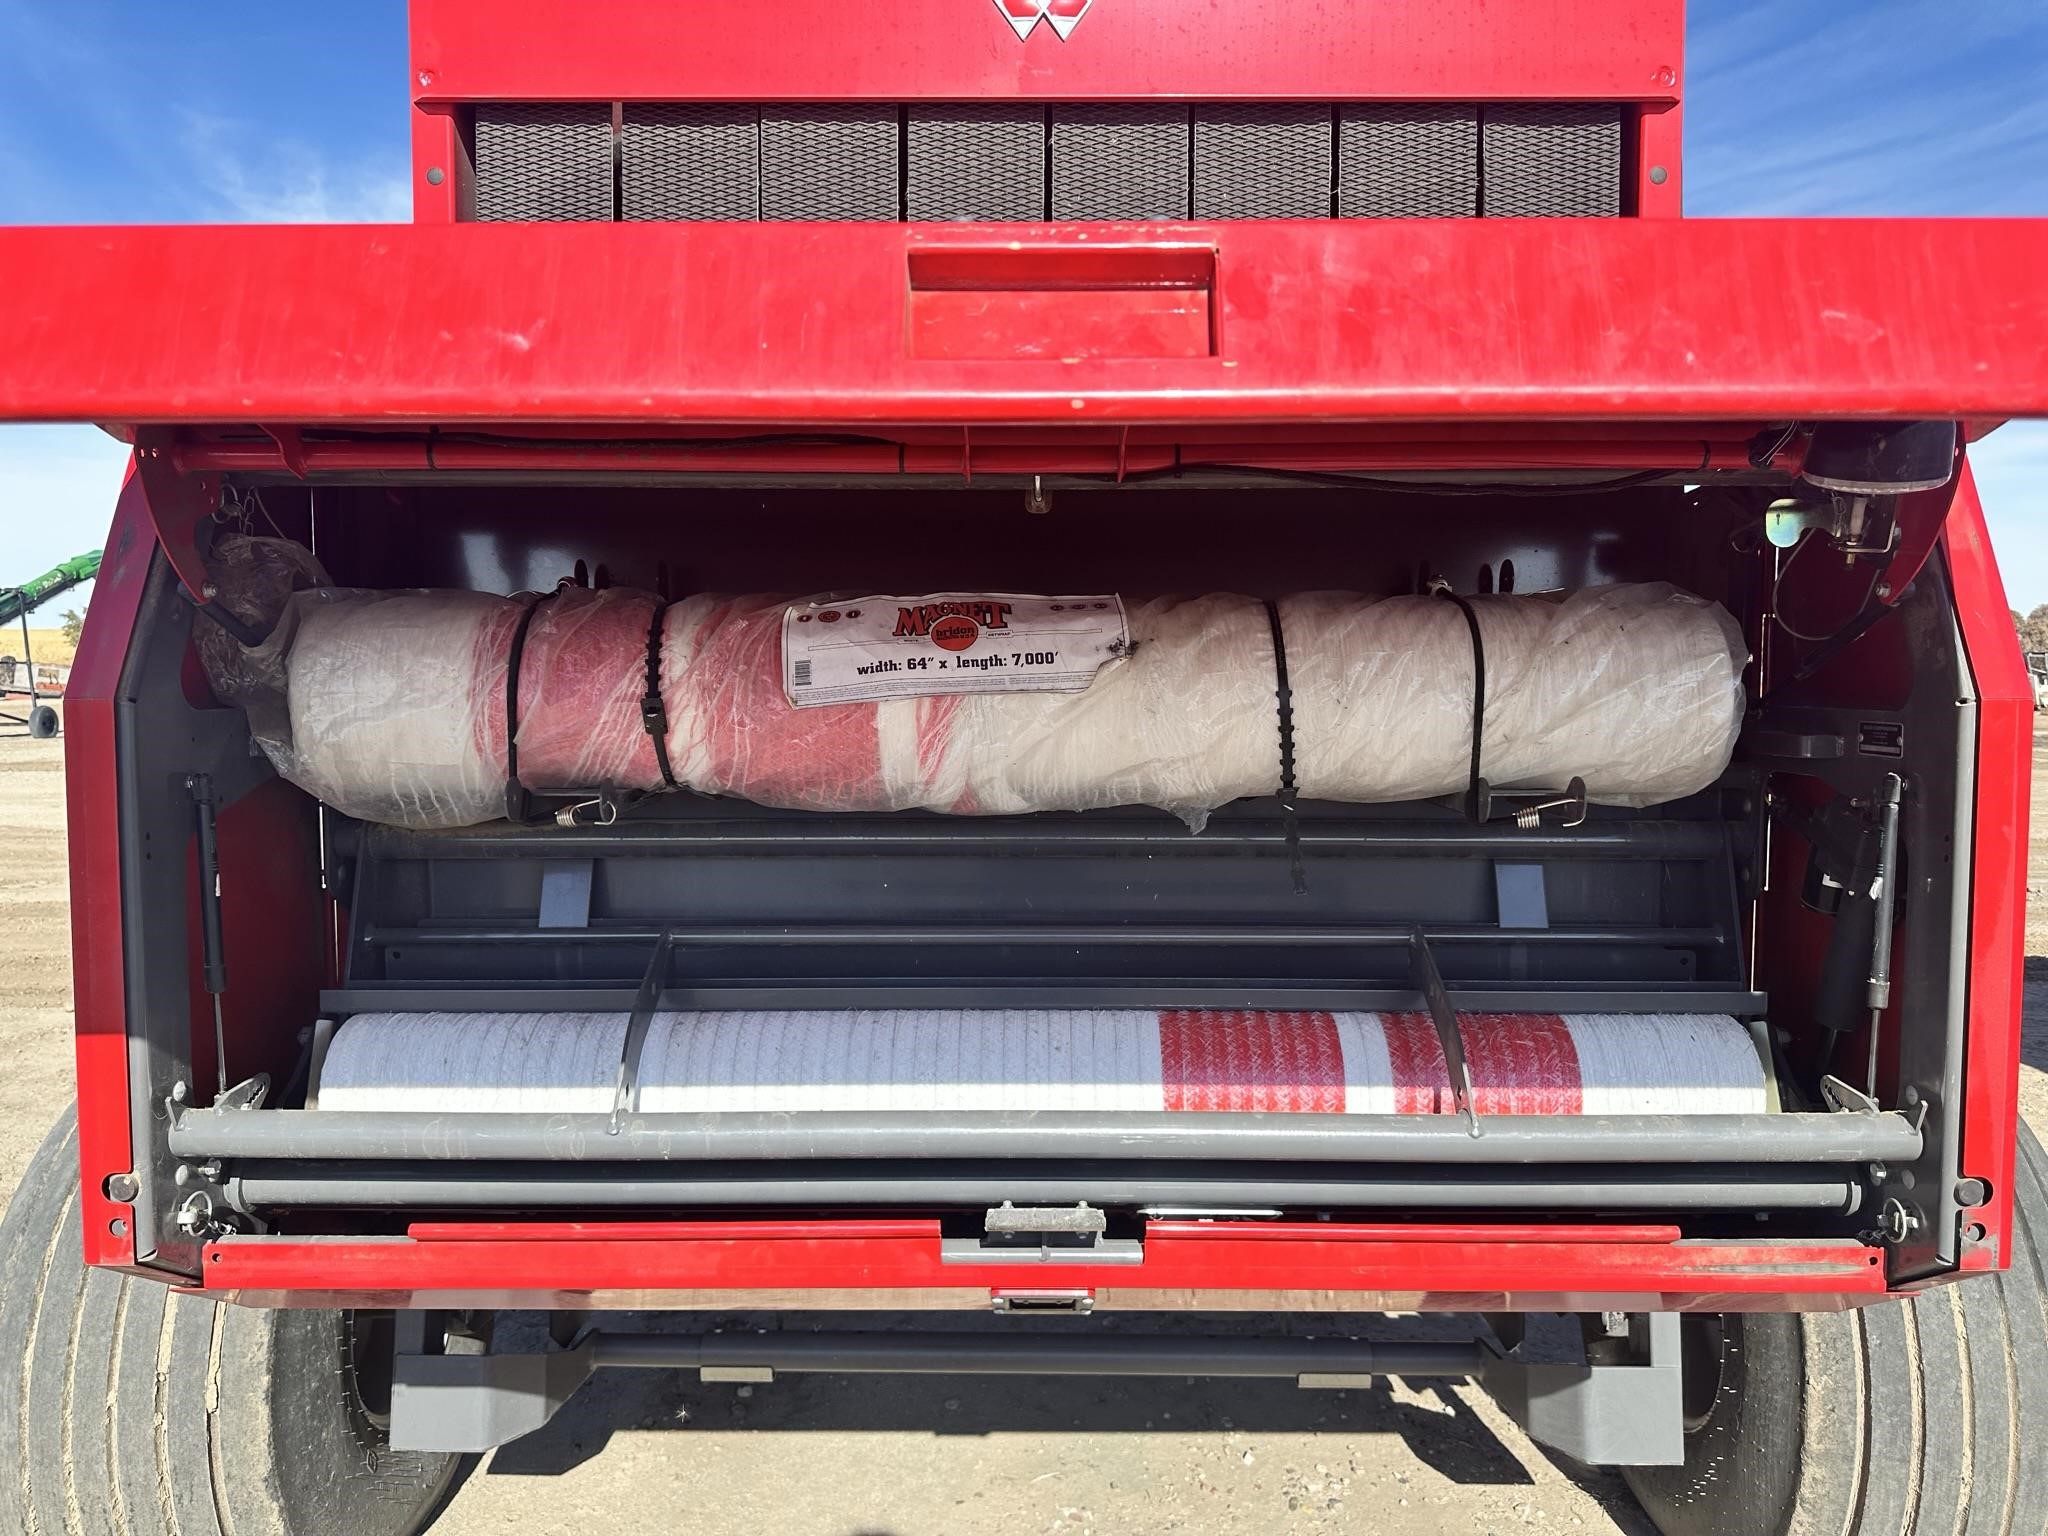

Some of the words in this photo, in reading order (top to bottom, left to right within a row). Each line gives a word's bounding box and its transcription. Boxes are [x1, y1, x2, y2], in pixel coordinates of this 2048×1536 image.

[892, 600, 1013, 637] MAGNET
[935, 626, 976, 637] bridon
[856, 660, 902, 675] width:
[907, 657, 934, 670] 64"
[938, 659, 948, 669] x
[956, 654, 1008, 671] length:
[1011, 651, 1059, 668] 7,000'
